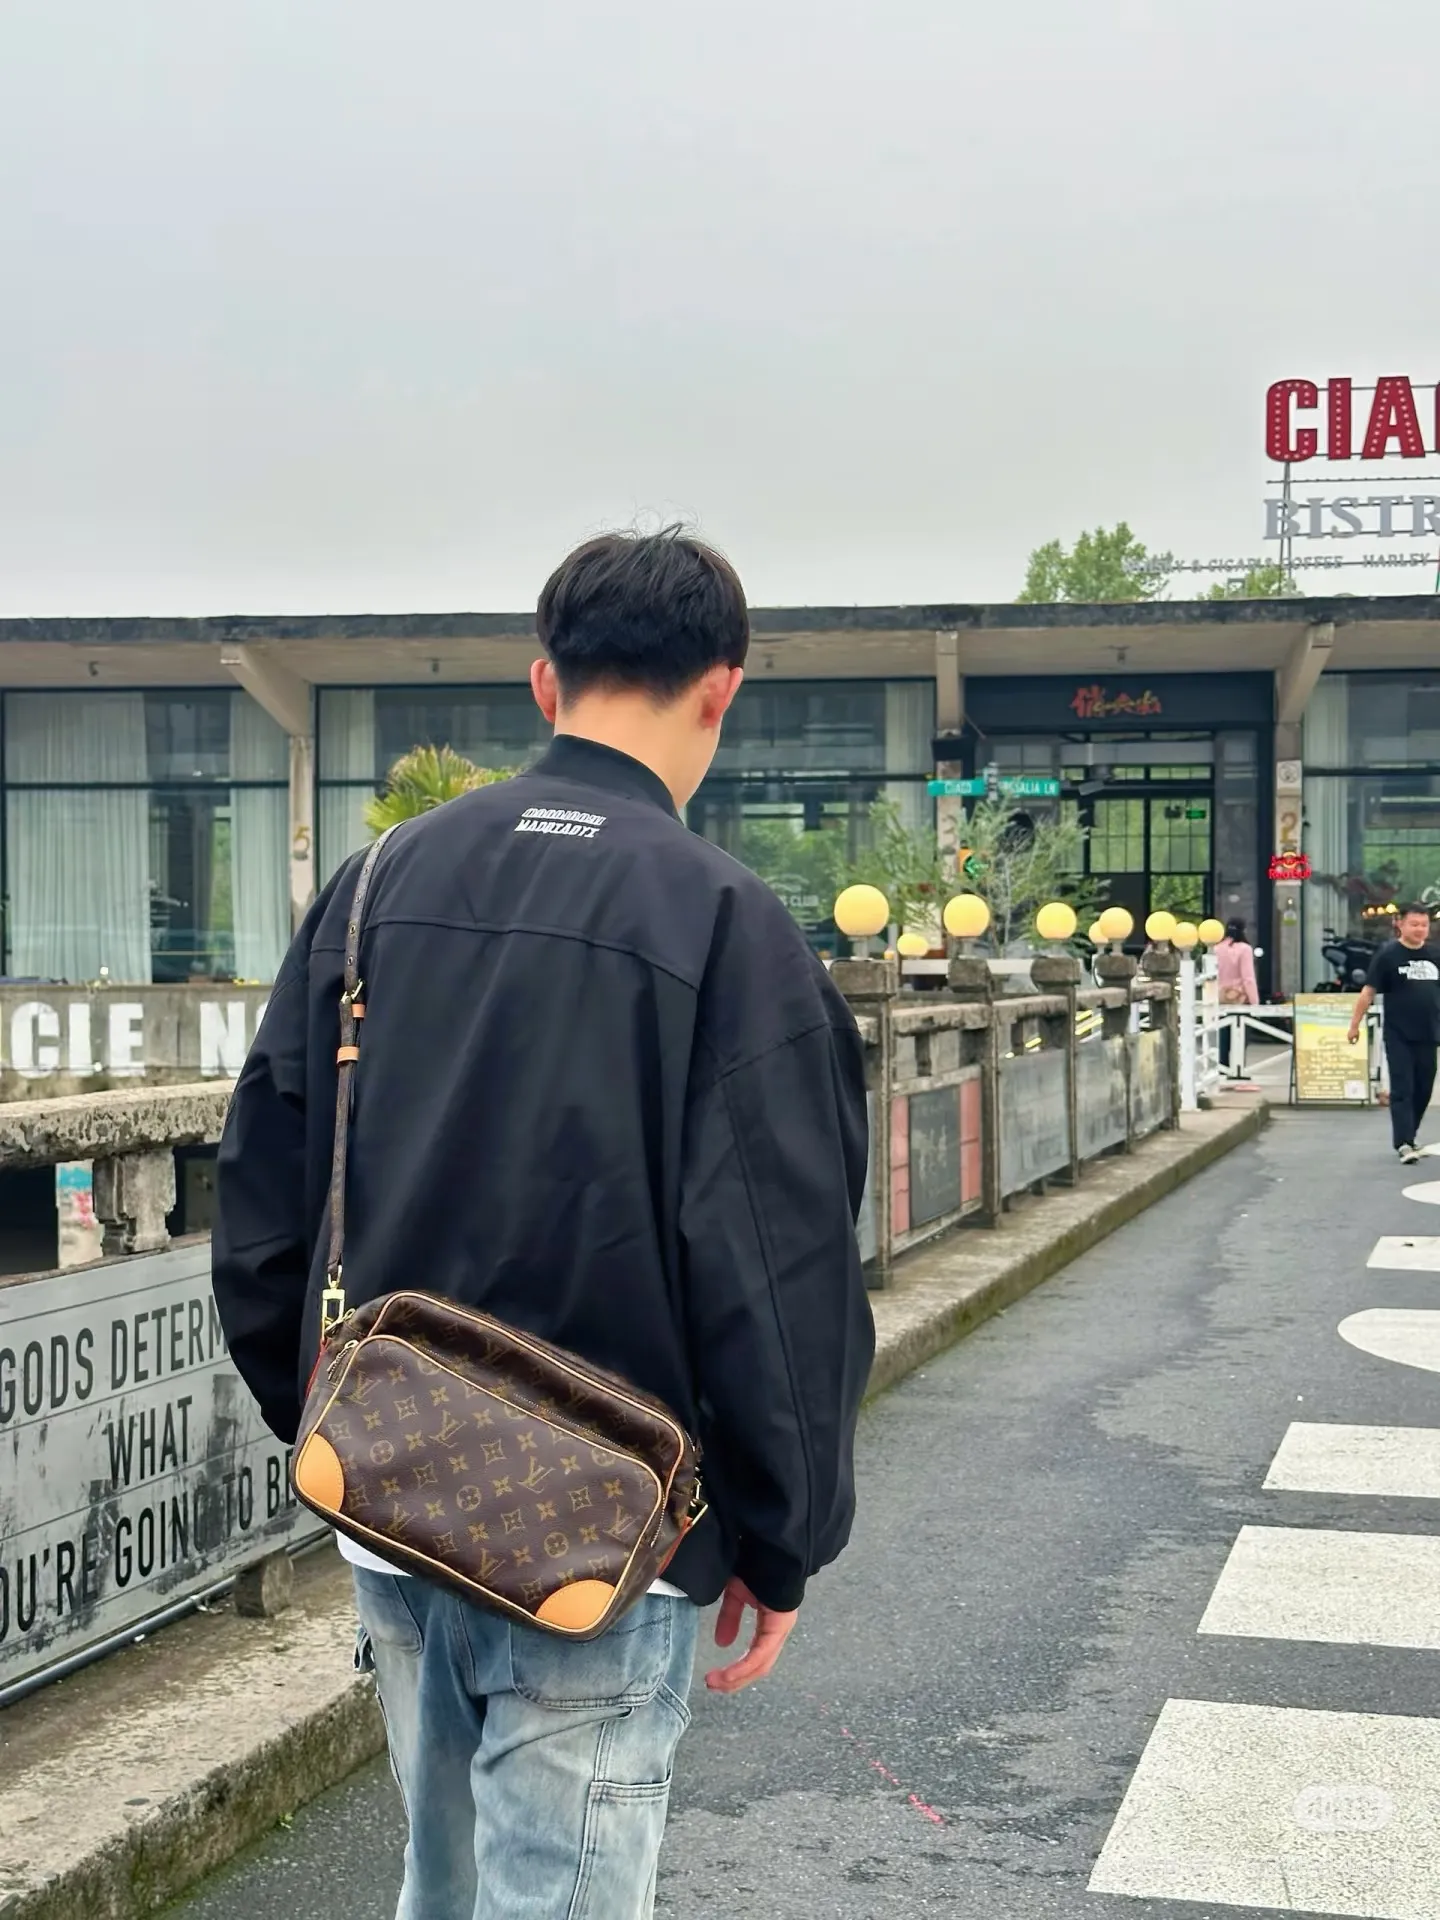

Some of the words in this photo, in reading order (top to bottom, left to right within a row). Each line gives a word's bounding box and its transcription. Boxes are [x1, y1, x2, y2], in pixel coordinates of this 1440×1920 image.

[1266, 375, 1440, 463] CIA
[1263, 495, 1440, 540] BISTR
[1363, 552, 1430, 568] HARLEY
[1280, 812, 1298, 844] 2
[200, 1001, 268, 1078] N
[0, 1327, 94, 1424] GODS
[107, 1395, 192, 1490] WHAT
[222, 1466, 253, 1538] TO
